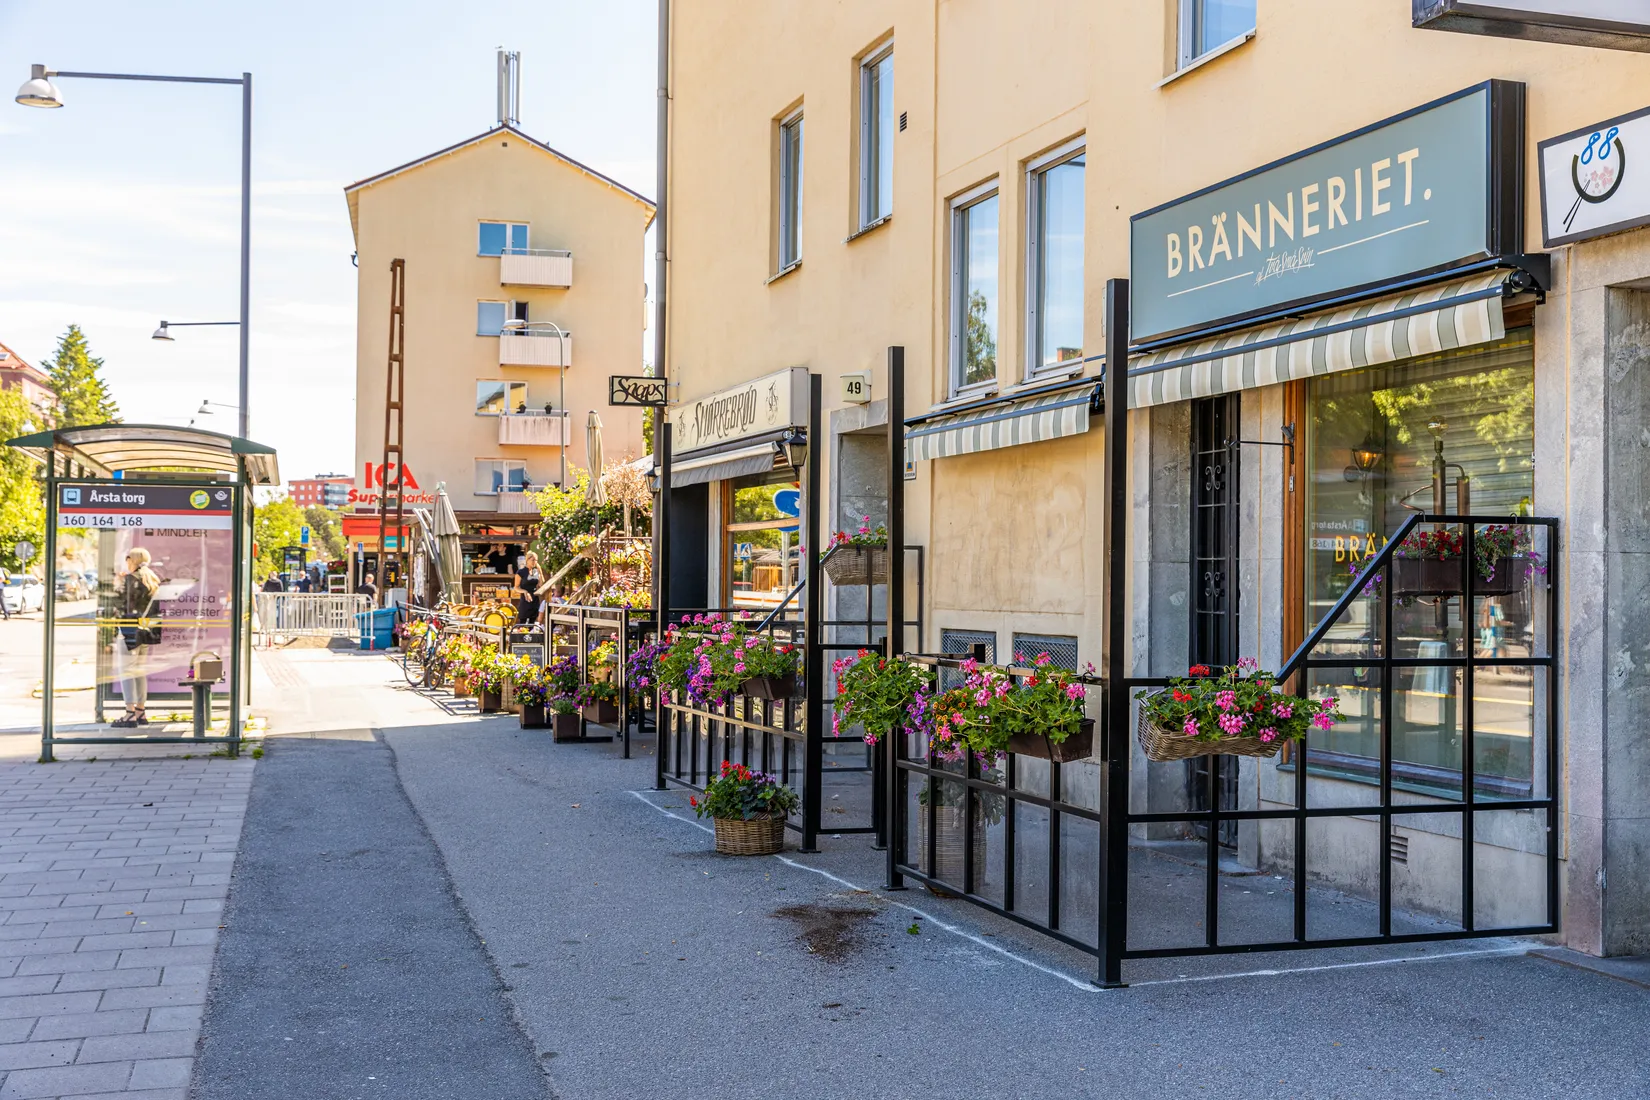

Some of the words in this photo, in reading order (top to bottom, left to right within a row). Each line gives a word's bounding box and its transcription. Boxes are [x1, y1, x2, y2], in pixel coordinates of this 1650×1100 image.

[1581, 127, 1619, 165] 88
[1167, 148, 1432, 279] BRÄNNERIET.
[847, 381, 861, 394] 49
[365, 462, 420, 489] ICA
[89, 489, 121, 503] Årsta
[123, 492, 146, 505] torg
[63, 515, 86, 526] 160
[92, 515, 114, 526] 164
[121, 516, 143, 527] 168
[157, 528, 208, 537] MINDLER
[168, 607, 221, 617] semester
